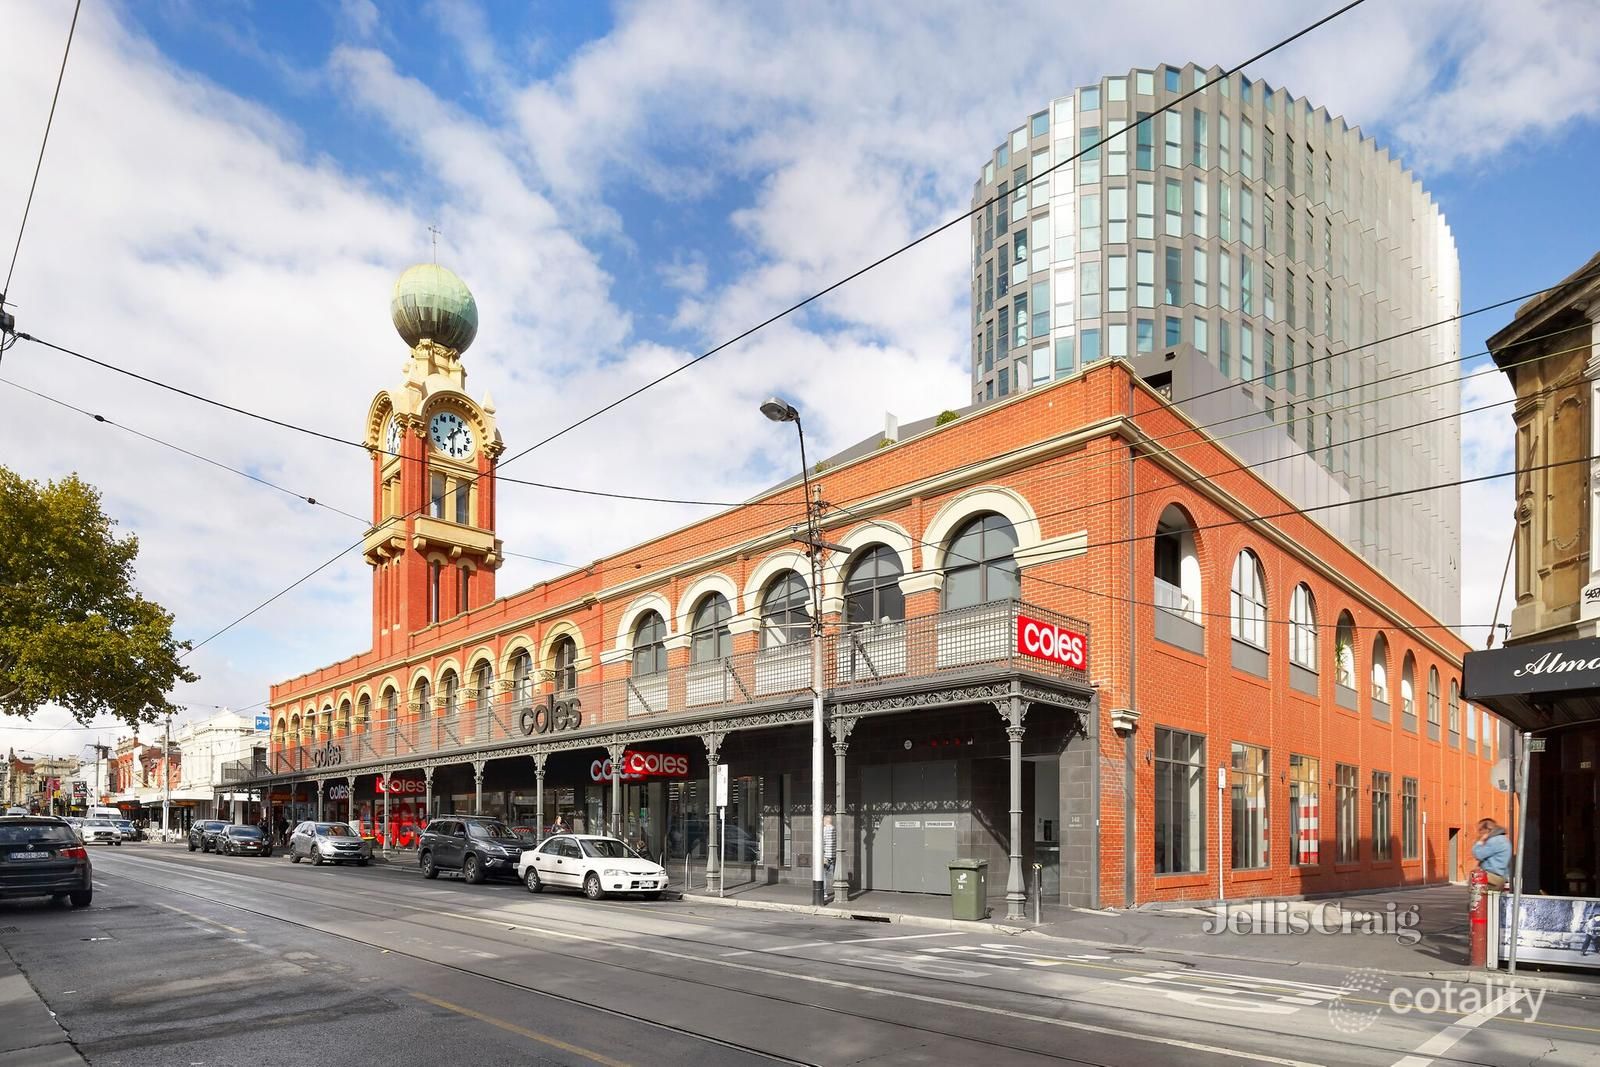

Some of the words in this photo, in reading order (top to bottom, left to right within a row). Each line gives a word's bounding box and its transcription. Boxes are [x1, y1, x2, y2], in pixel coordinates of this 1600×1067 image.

[1023, 622, 1083, 665] coles
[519, 694, 581, 735] coles
[314, 740, 342, 768] coles
[630, 753, 688, 775] coles
[329, 784, 349, 800] coles
